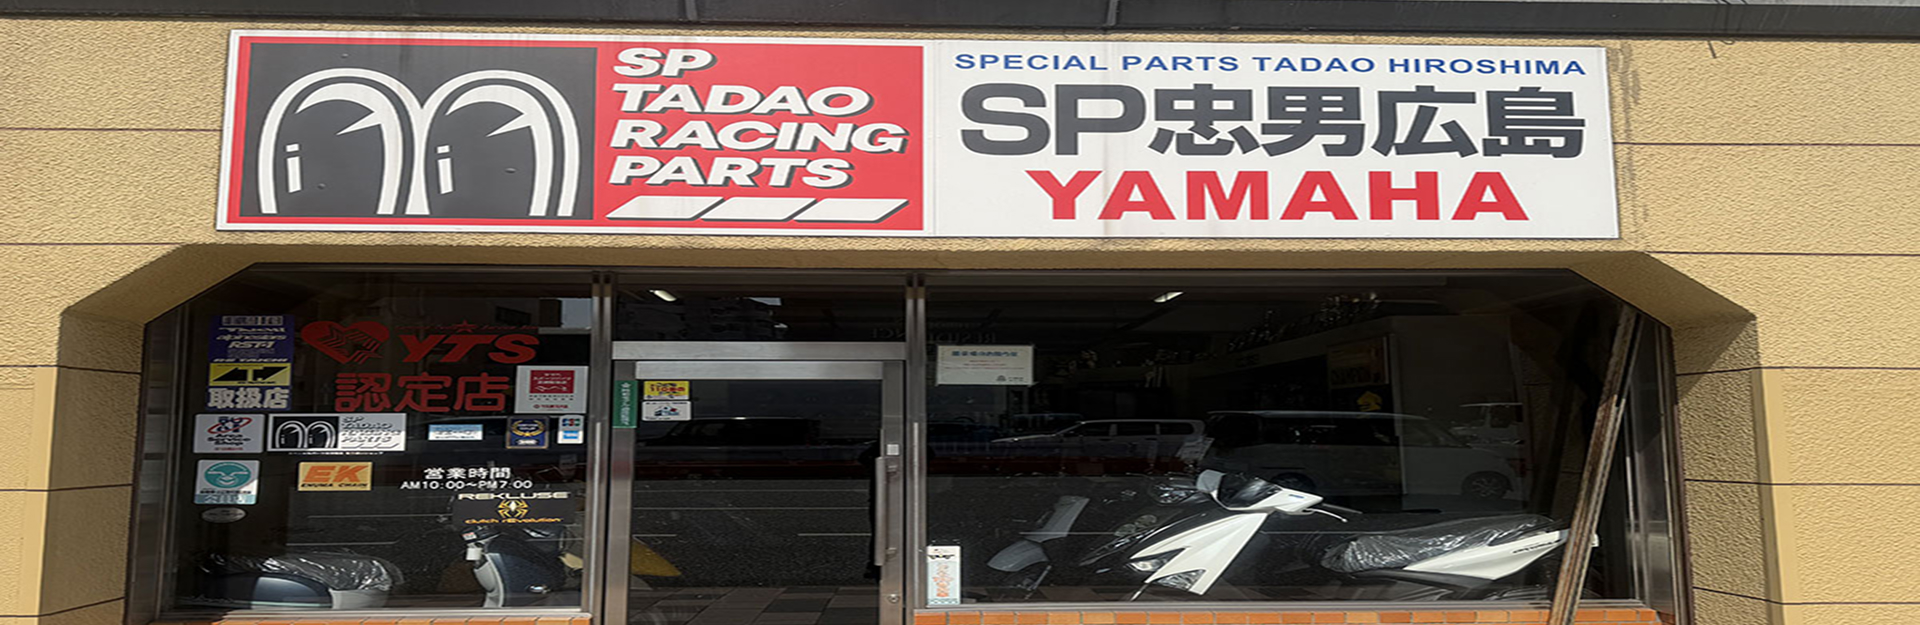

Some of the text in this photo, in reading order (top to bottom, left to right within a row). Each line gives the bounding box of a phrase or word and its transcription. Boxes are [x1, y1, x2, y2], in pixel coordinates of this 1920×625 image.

[613, 47, 715, 78] SP
[955, 54, 1586, 75] SPECIAL PARTS TADAO HIROSHIMA
[612, 83, 872, 117] TADAO
[610, 119, 907, 154] RACING
[960, 83, 1586, 159] SP忠男広島
[609, 155, 853, 189] PARTS
[1025, 170, 1530, 221] YAMAHA
[401, 334, 539, 364] YTS
[207, 387, 290, 409] 取扱店
[335, 372, 510, 412] 認定店
[303, 465, 369, 483] EK
[423, 467, 512, 480] 営業時間
[458, 491, 569, 500] REKLUSE
